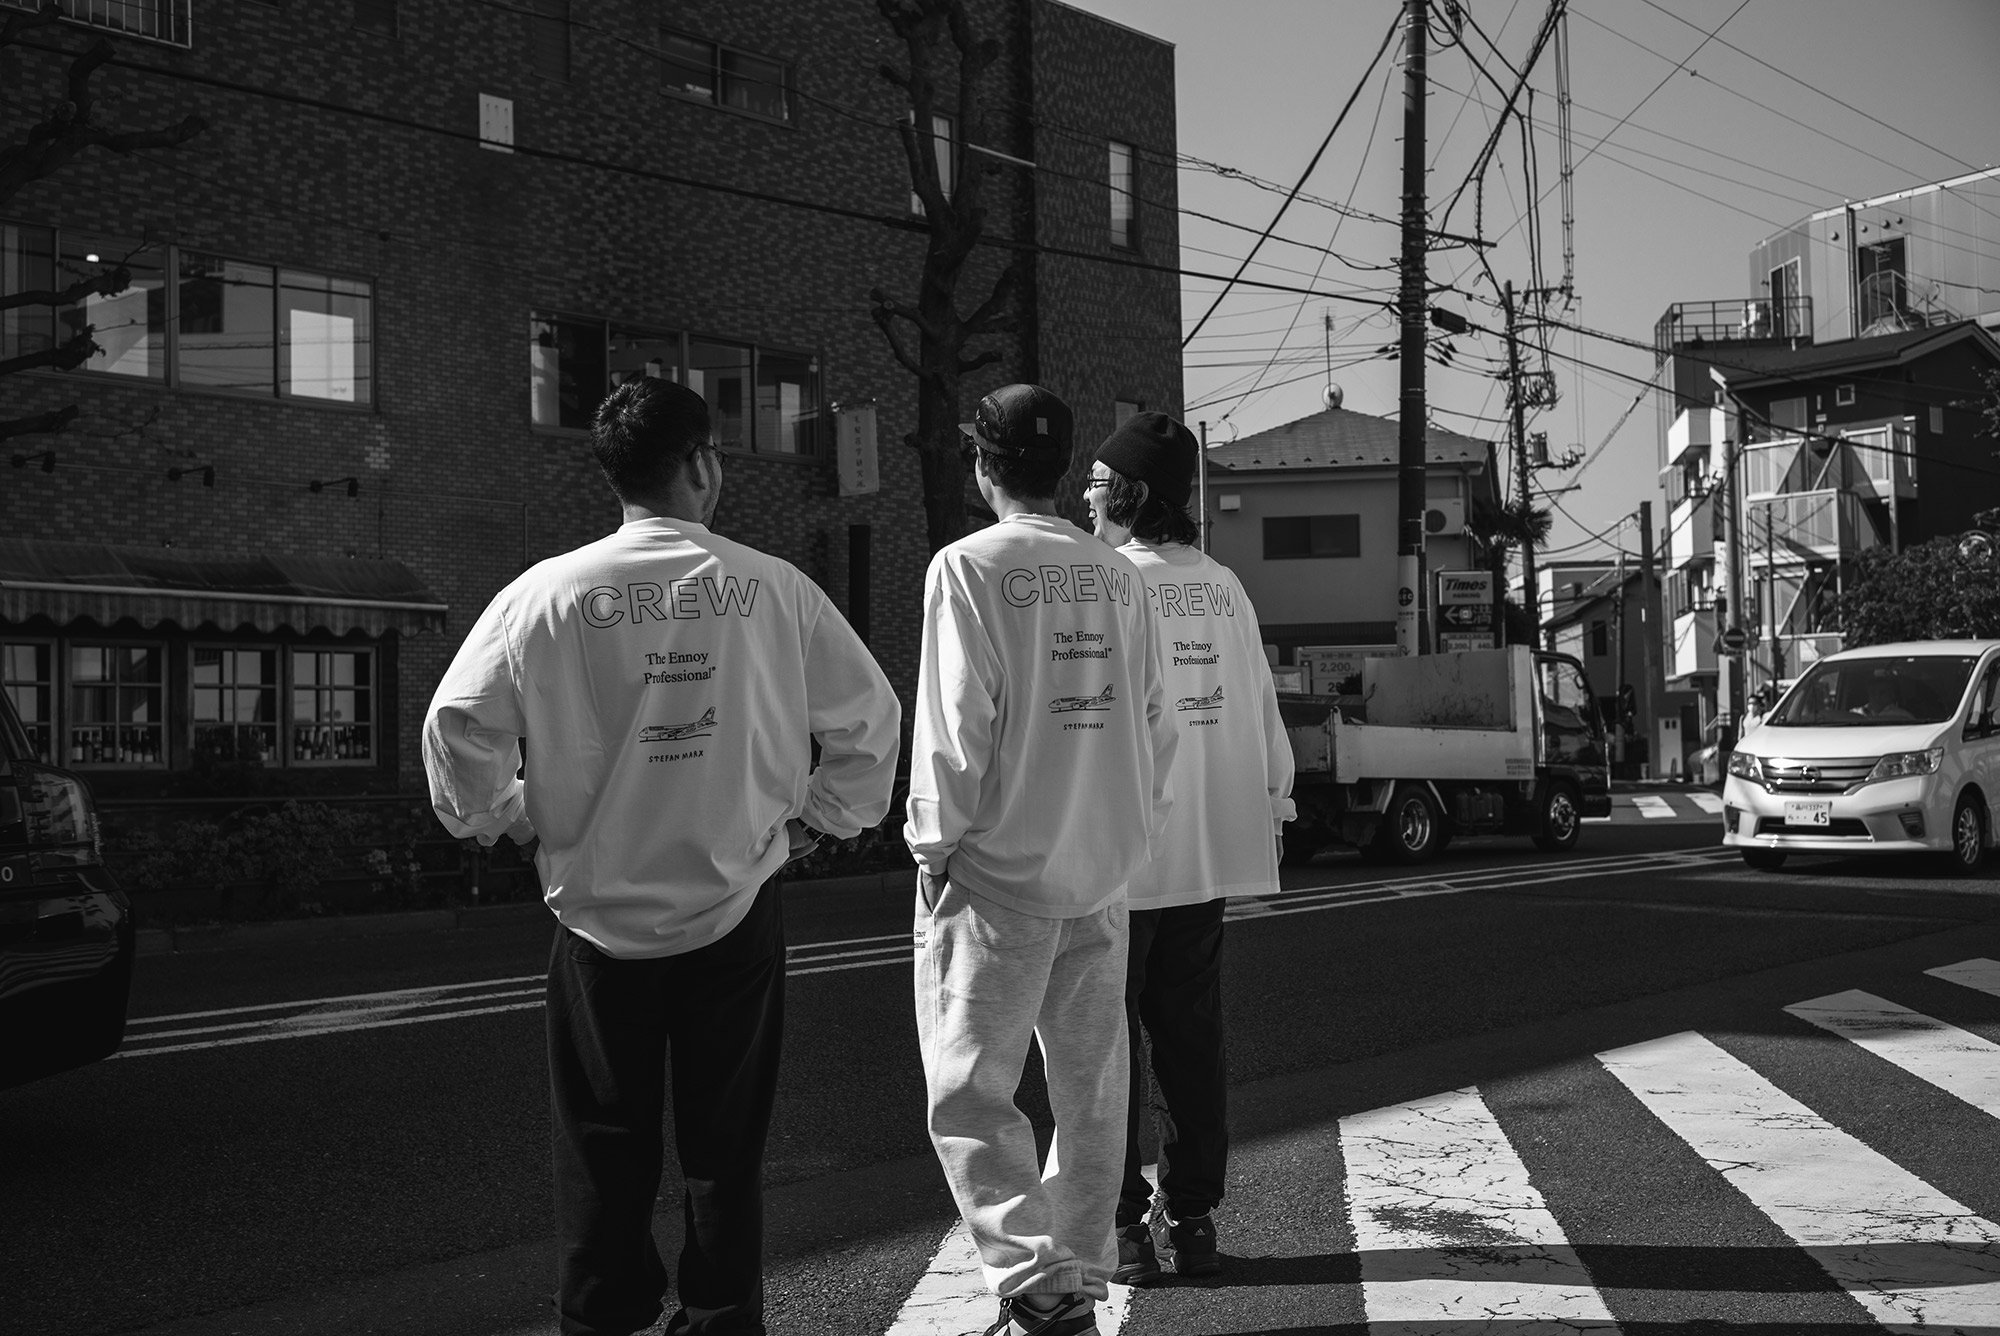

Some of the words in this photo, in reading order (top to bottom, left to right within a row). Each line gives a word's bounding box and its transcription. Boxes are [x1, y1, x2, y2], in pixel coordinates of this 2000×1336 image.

[1000, 564, 1131, 608] CREW
[1445, 578, 1487, 591] Times
[581, 575, 759, 628] CREW
[1147, 582, 1235, 618] REW
[1053, 632, 1073, 644] The
[1075, 630, 1104, 645] Ennoy
[1172, 640, 1191, 652] The
[644, 652, 667, 665] The
[668, 651, 709, 665] Ennoy
[1320, 662, 1352, 674] 2,200
[648, 754, 680, 763] STEFAN
[681, 749, 704, 760] MARX
[1813, 811, 1827, 824] 45
